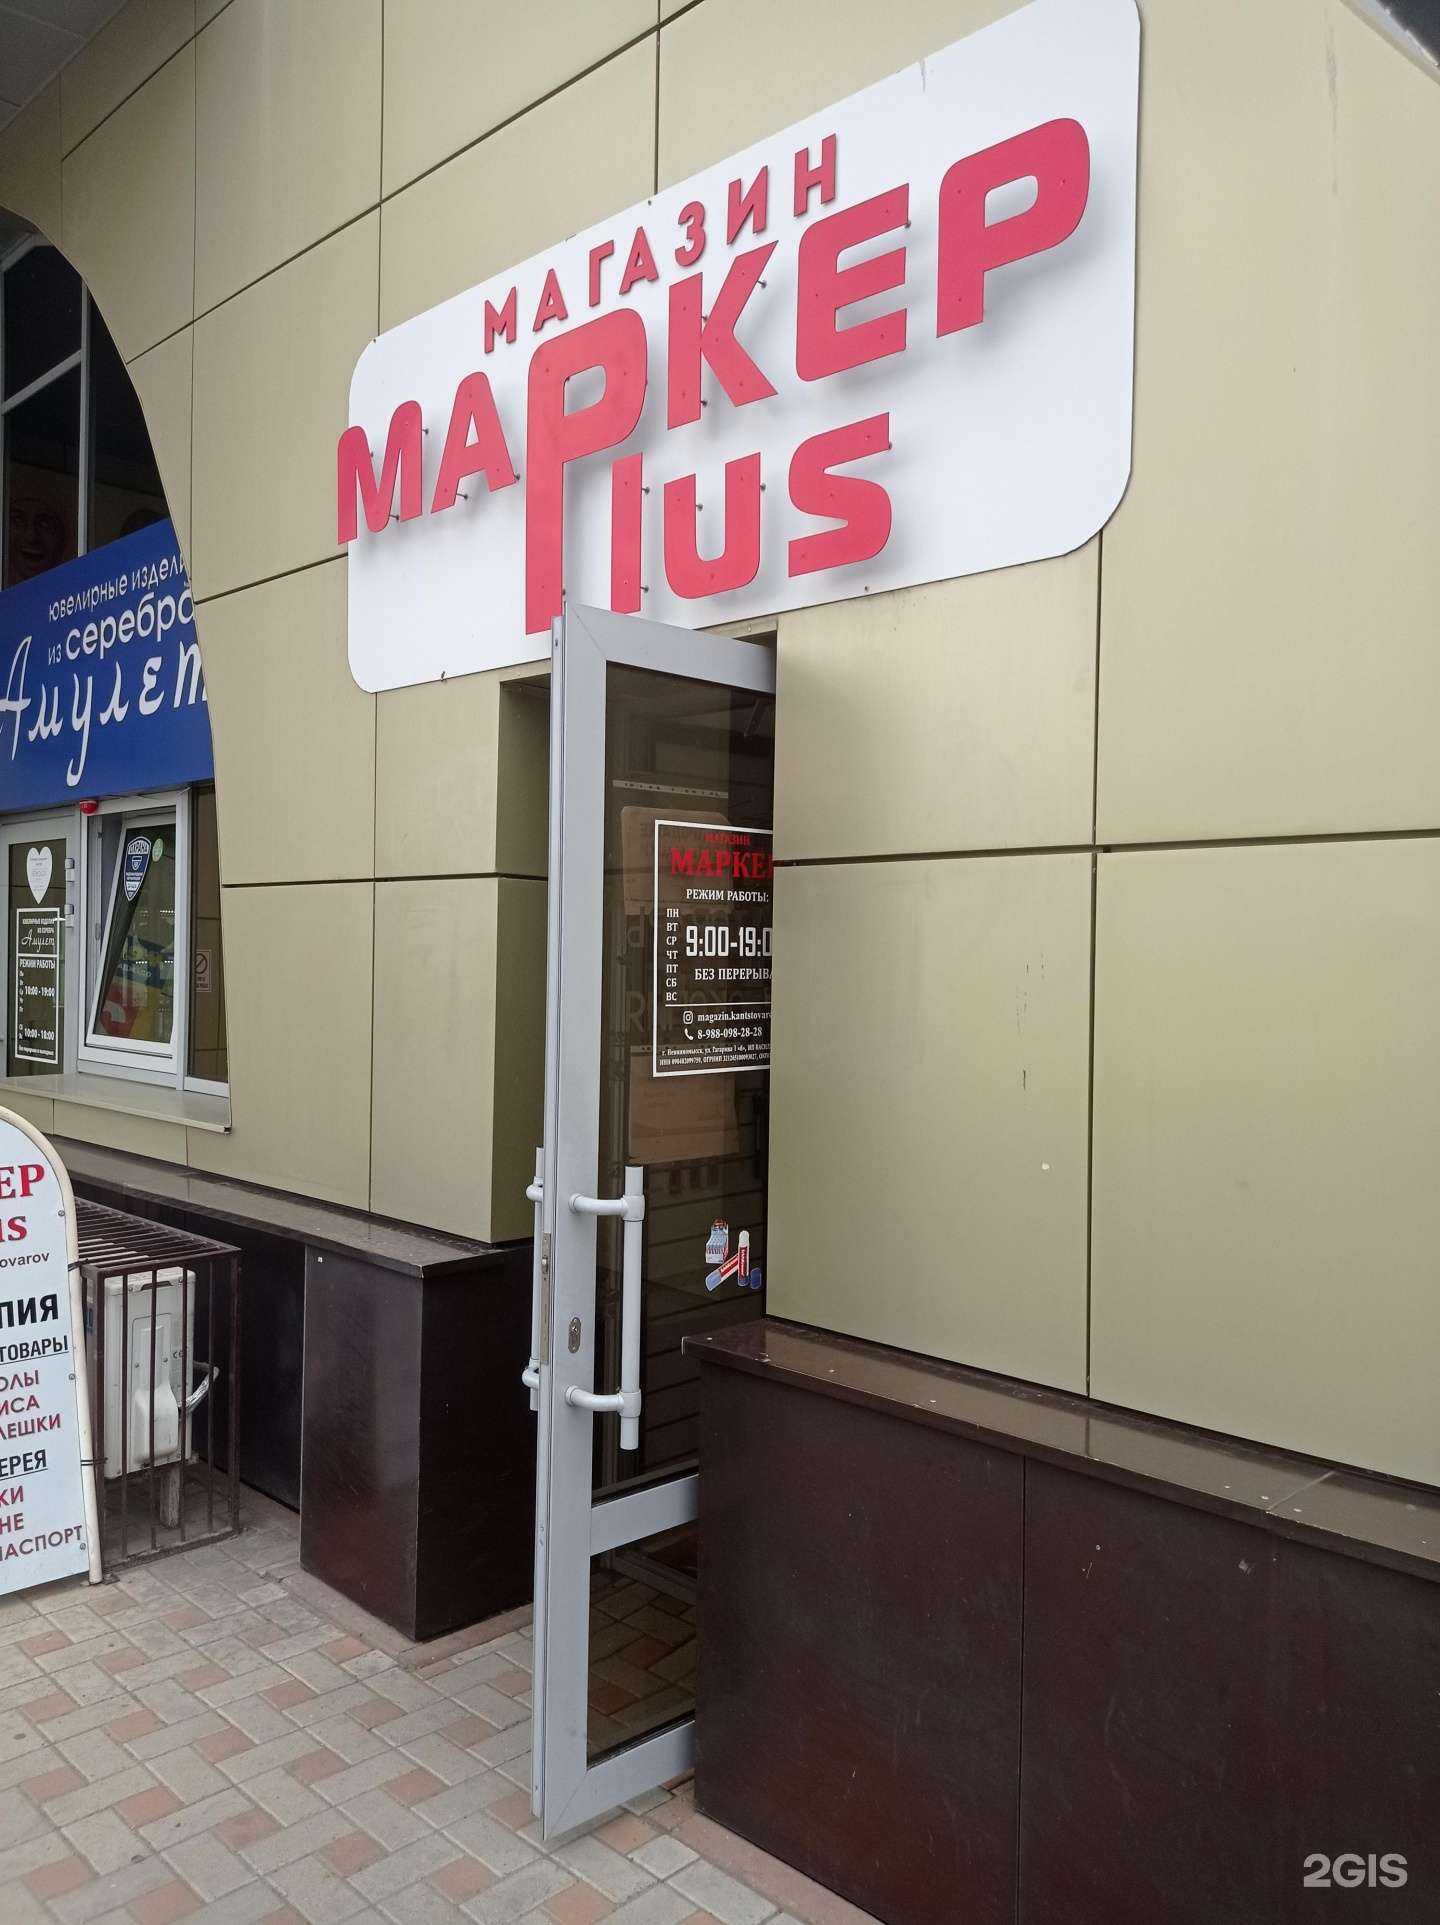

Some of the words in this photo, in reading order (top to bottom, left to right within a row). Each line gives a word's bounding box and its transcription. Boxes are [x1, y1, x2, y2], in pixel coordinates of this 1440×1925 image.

[484, 133, 837, 354] МАГАЗИН
[337, 117, 1091, 635] МАРКЕР
[49, 573, 128, 622] ювелирные
[48, 643, 62, 665] из
[686, 888, 724, 901] РЕЖИМ
[727, 890, 769, 903] РАБОТЫ:
[666, 908, 679, 918] ПН
[666, 922, 679, 932] ВТ
[22, 928, 55, 953] Амулет
[666, 936, 677, 946] СР
[666, 950, 679, 960] ЧТ
[666, 964, 679, 973] ПТ
[695, 968, 715, 981] БЕЗ
[666, 978, 677, 987] СБ
[666, 991, 677, 1001] ВС
[697, 1026, 763, 1040] 8-988-098-28-28
[0, 1525, 83, 1562] АСПОРТ
